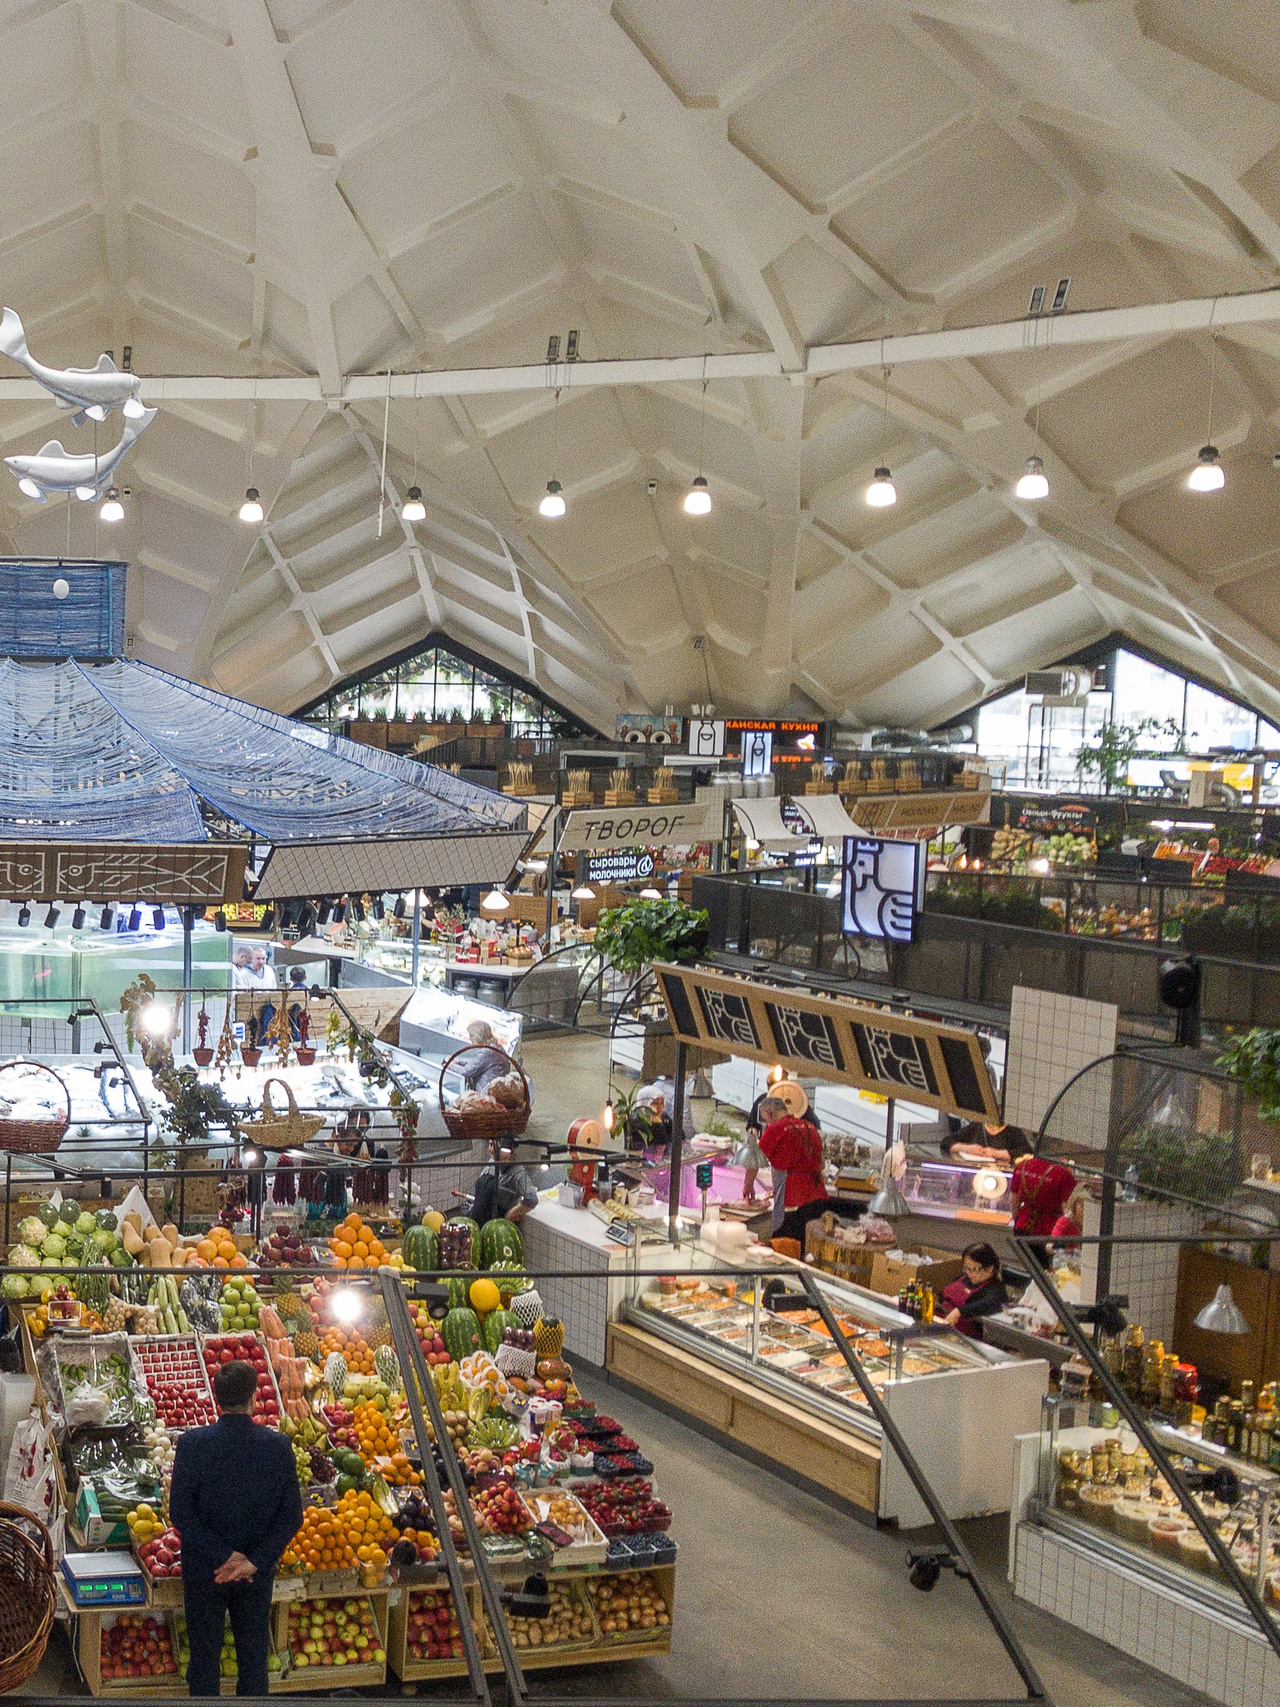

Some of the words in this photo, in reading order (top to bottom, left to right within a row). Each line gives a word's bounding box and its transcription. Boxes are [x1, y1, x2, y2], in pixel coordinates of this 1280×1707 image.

[725, 720, 776, 730] КАНСКАЯ
[781, 722, 819, 732] КУХНЯ
[585, 815, 685, 841] ТВОРОГ
[589, 855, 637, 869] сыровары
[589, 868, 637, 881] молочники
